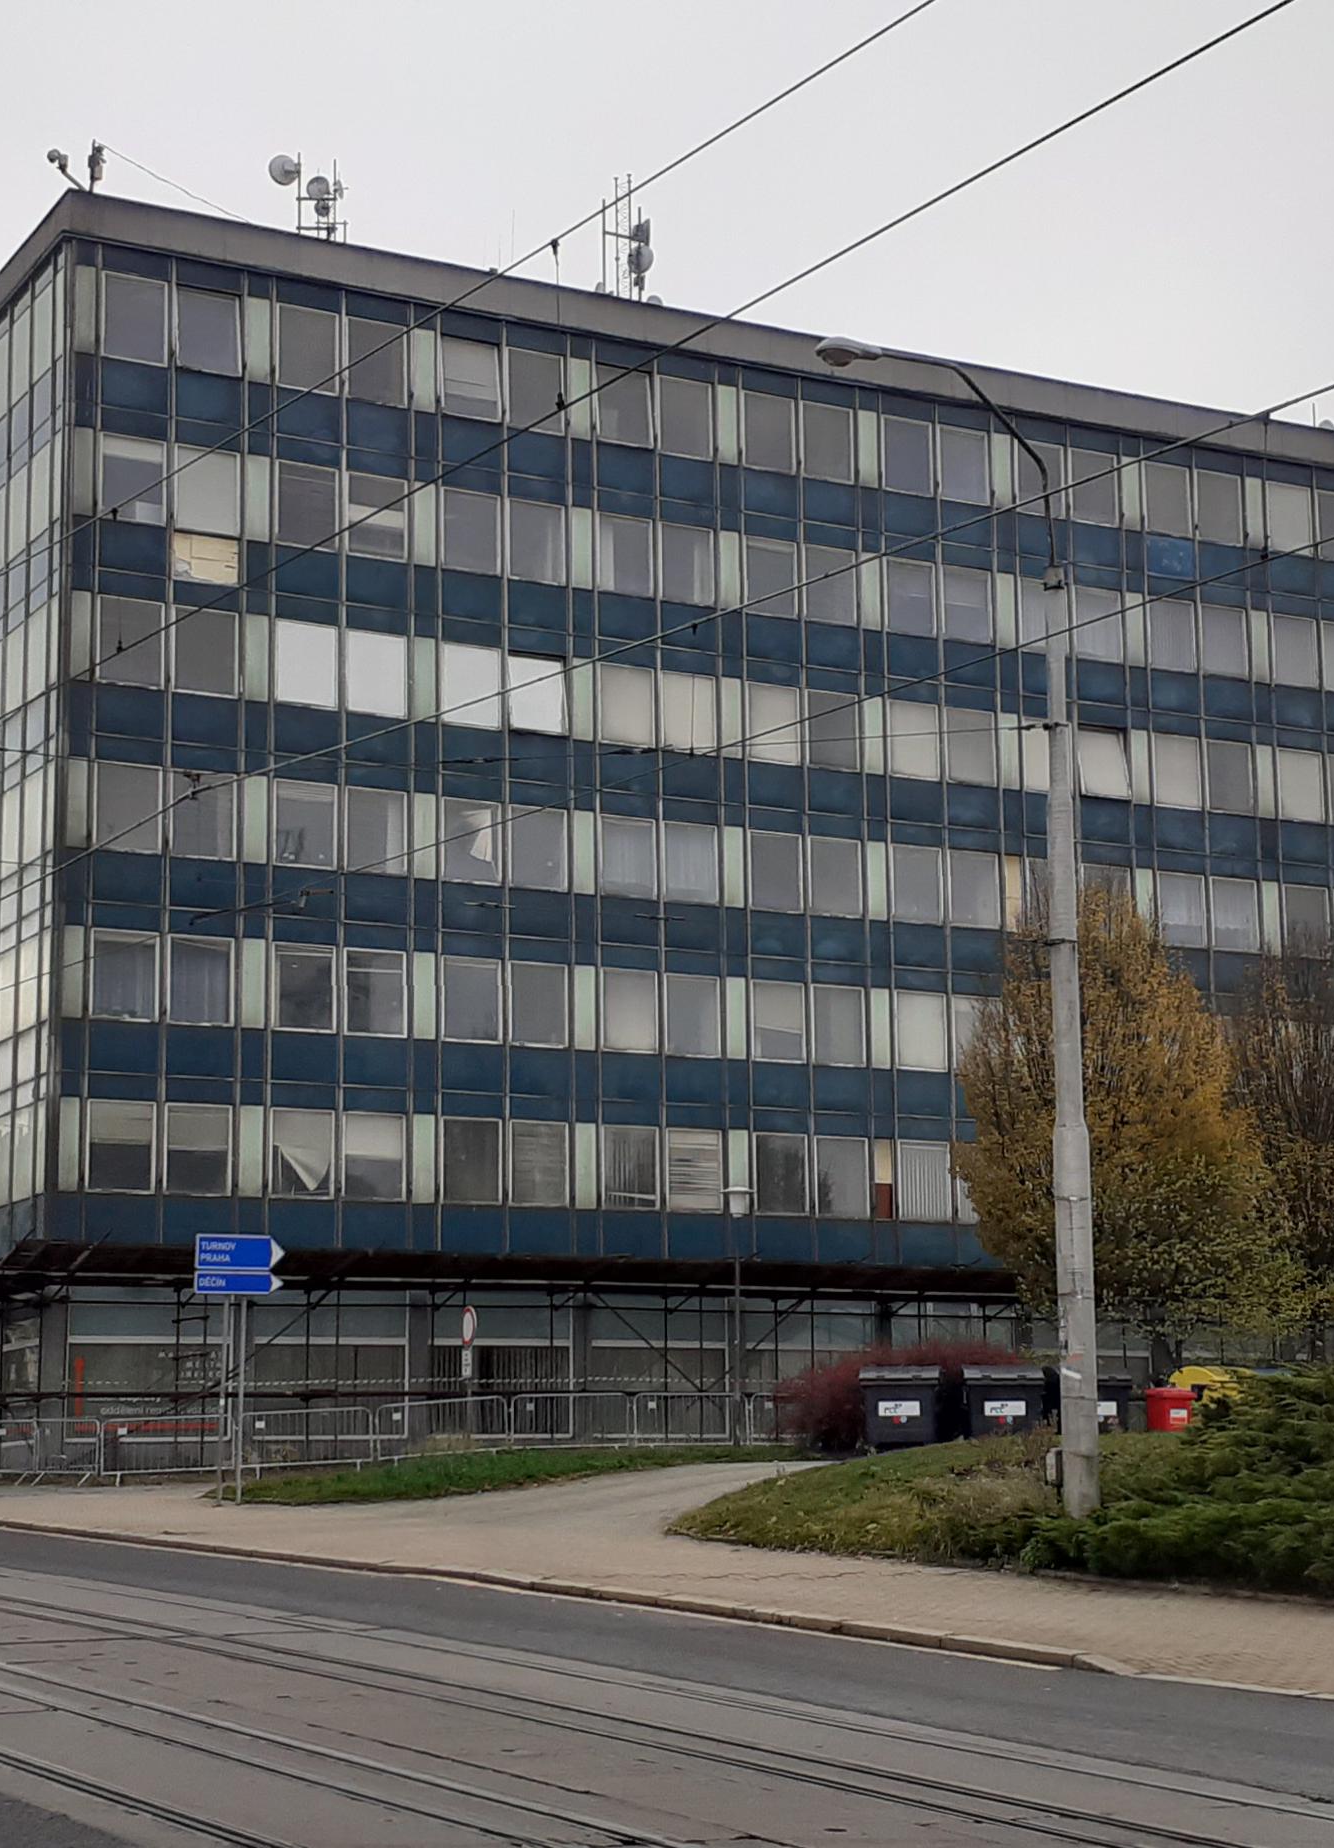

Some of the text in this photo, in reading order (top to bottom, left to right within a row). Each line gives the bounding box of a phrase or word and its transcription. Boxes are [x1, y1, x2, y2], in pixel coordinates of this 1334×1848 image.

[201, 1241, 237, 1250] TURNOV
[200, 1252, 231, 1263] PRAHA
[198, 1276, 226, 1287] DĚČÍN
